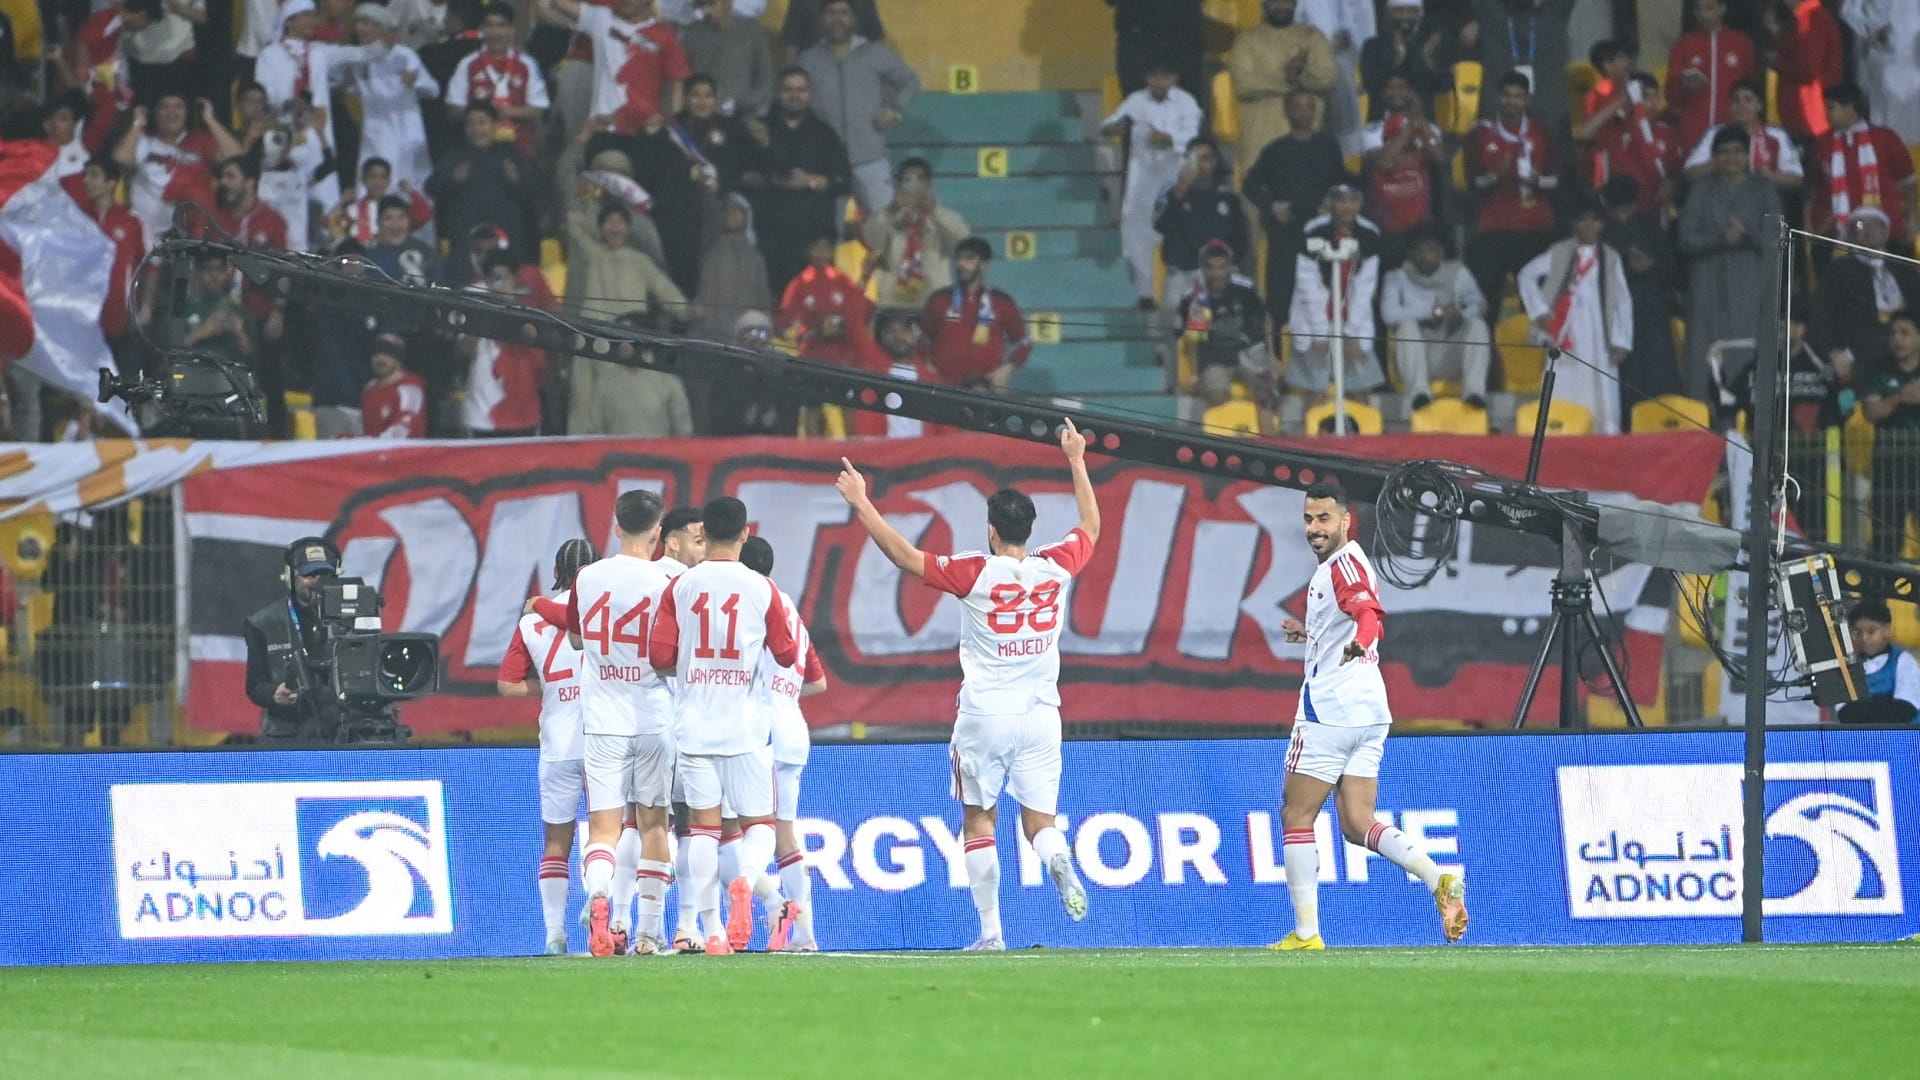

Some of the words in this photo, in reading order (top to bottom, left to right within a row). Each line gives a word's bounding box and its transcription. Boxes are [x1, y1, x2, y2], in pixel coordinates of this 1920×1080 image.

[955, 69, 971, 91] B
[984, 152, 1001, 174] C
[1010, 234, 1029, 257] D
[1038, 320, 1052, 339] E
[987, 579, 1060, 634] 88
[583, 591, 651, 658] 44
[691, 592, 740, 660] 11
[534, 619, 584, 683] 2
[600, 664, 640, 682] DAVID
[1578, 824, 1734, 870] أدنوك
[131, 844, 286, 889] أدنوك
[1584, 871, 1737, 902] ADNOC
[135, 891, 287, 923] ADNOC
